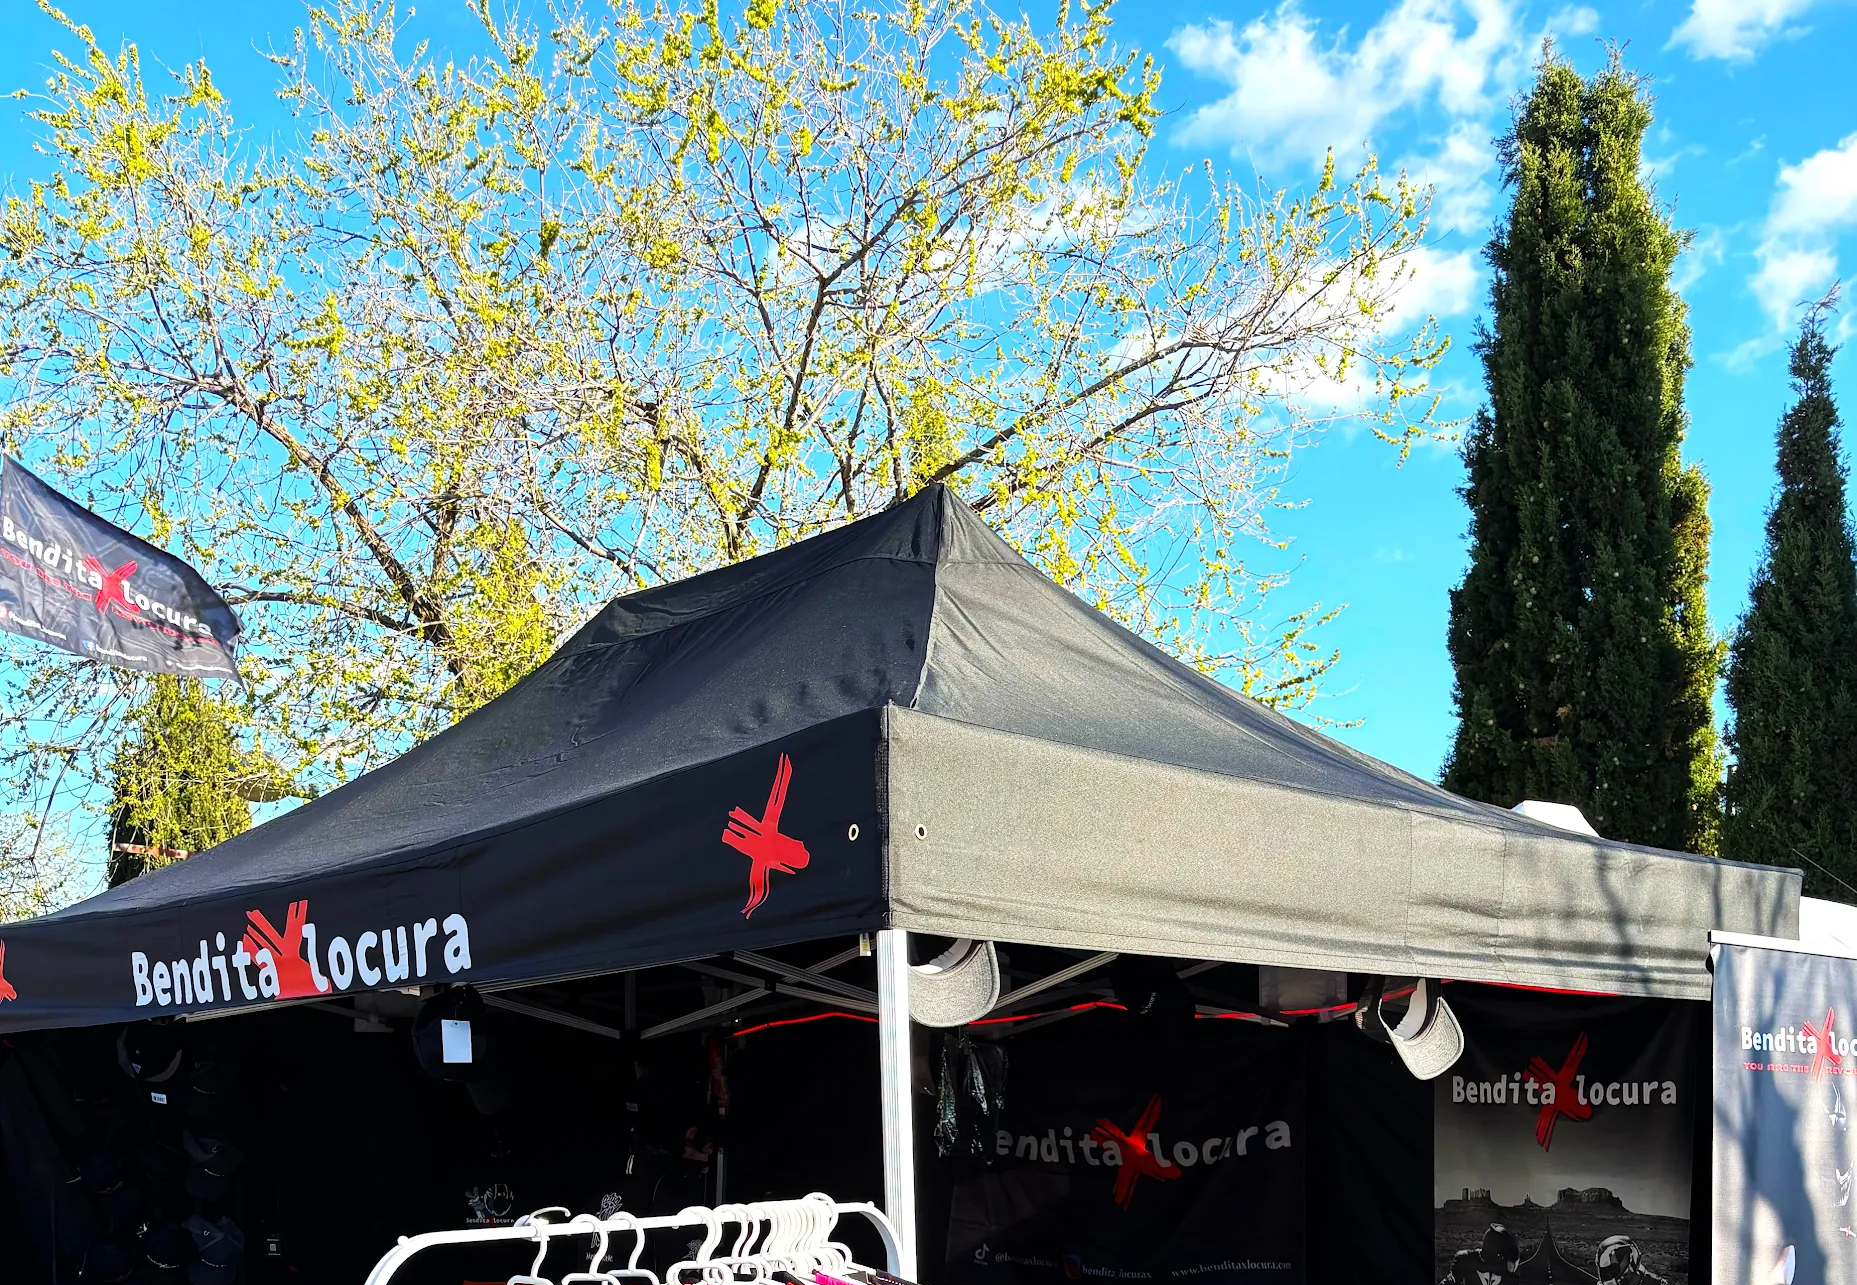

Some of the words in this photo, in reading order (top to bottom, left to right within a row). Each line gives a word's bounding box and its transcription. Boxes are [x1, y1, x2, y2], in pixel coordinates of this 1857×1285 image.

[3, 516, 102, 590] Bendita
[121, 580, 213, 636] locura
[132, 931, 281, 1008] Bendita
[302, 912, 471, 996] locura
[1741, 1026, 1818, 1054] Bendita
[1743, 1062, 1763, 1071] YOU
[1452, 1073, 1556, 1105] Bendita
[1576, 1075, 1678, 1105] locura
[996, 1127, 1123, 1167] endita
